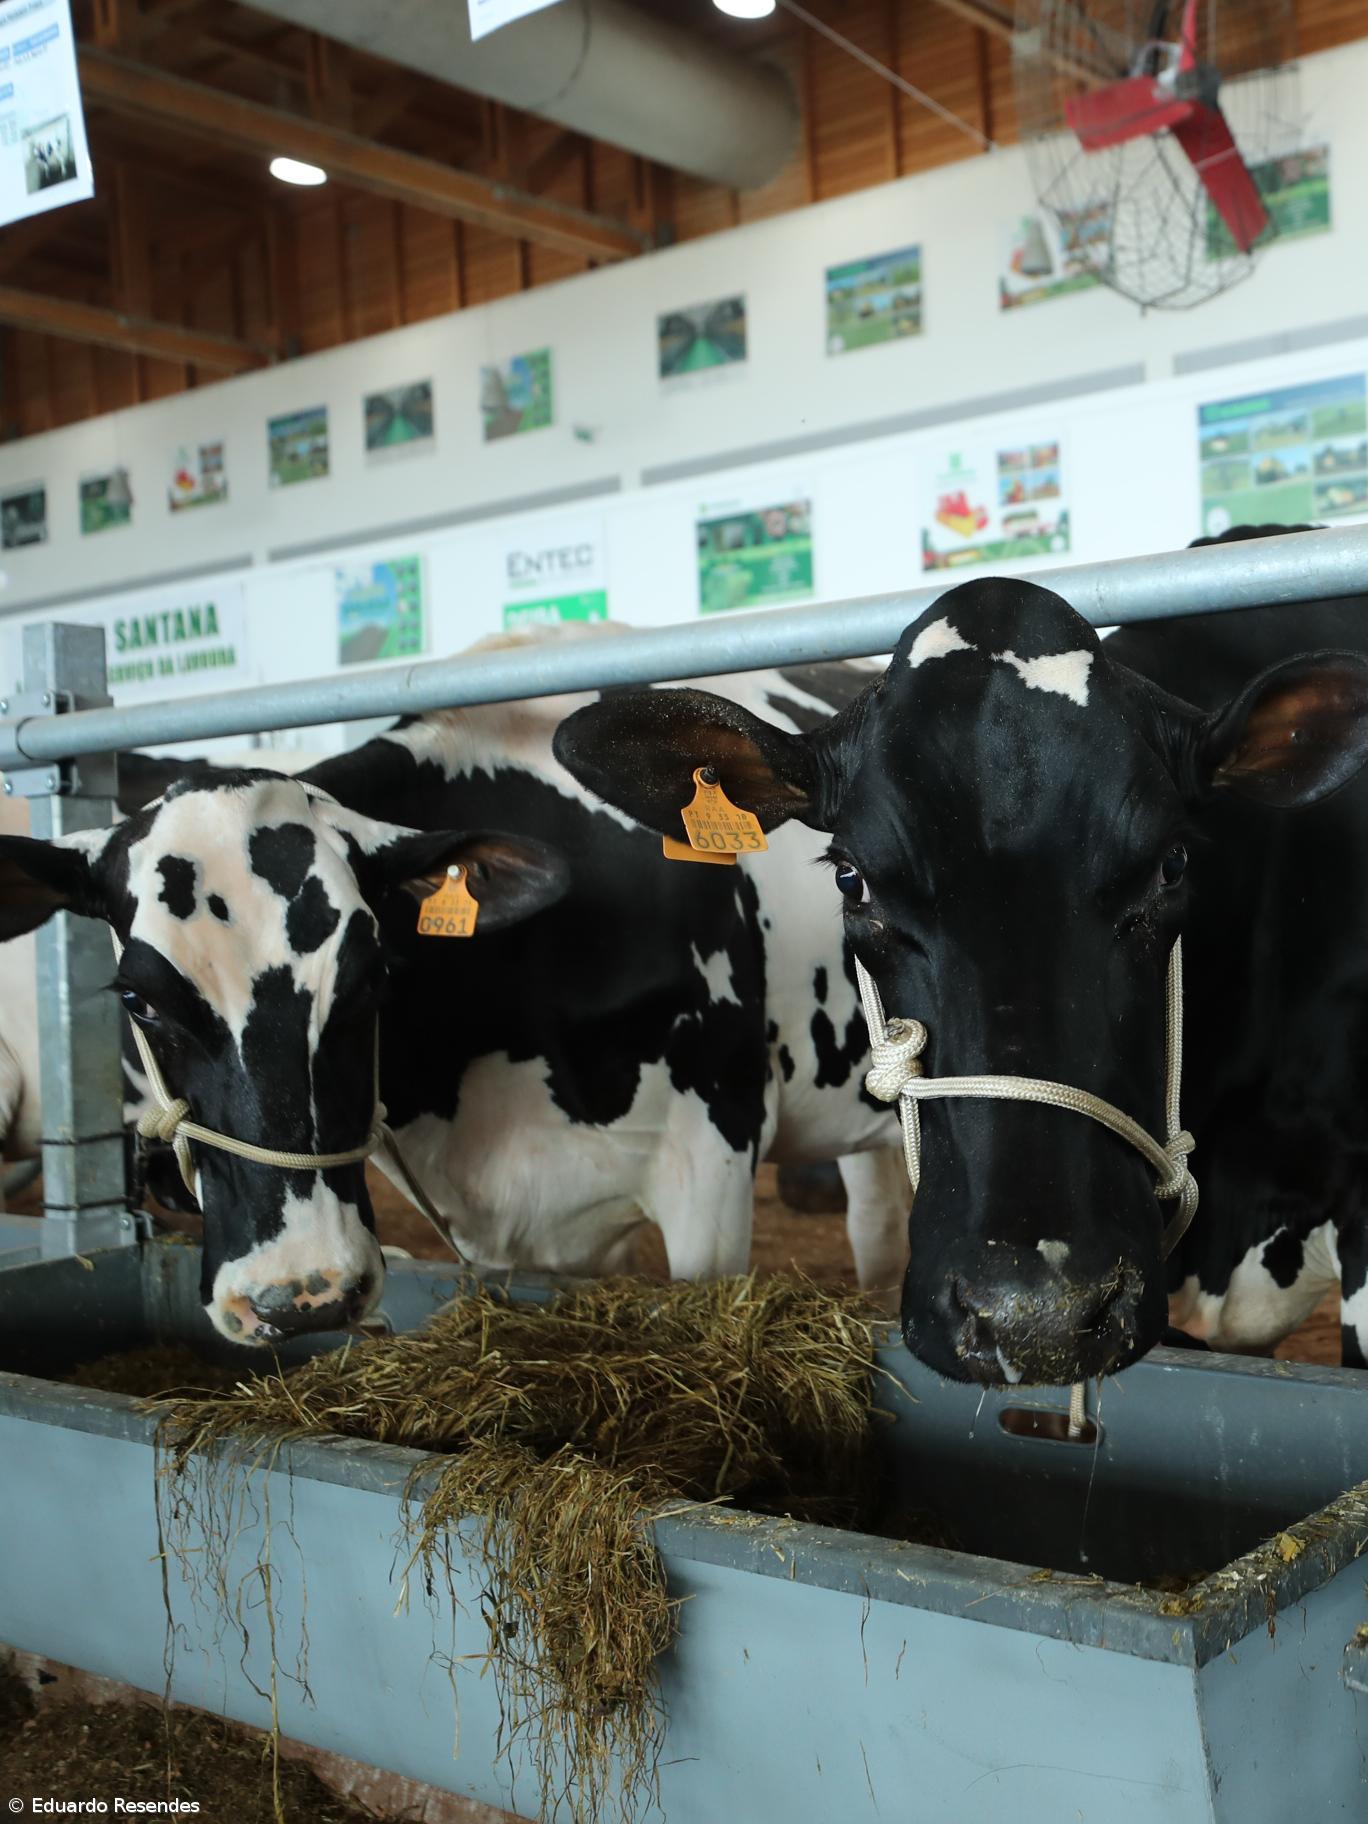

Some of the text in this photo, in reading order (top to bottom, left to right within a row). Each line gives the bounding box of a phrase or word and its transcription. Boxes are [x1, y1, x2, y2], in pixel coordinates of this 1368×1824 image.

[114, 603, 218, 652] SANTANA
[696, 831, 761, 850] 6033
[420, 916, 468, 934] 0961
